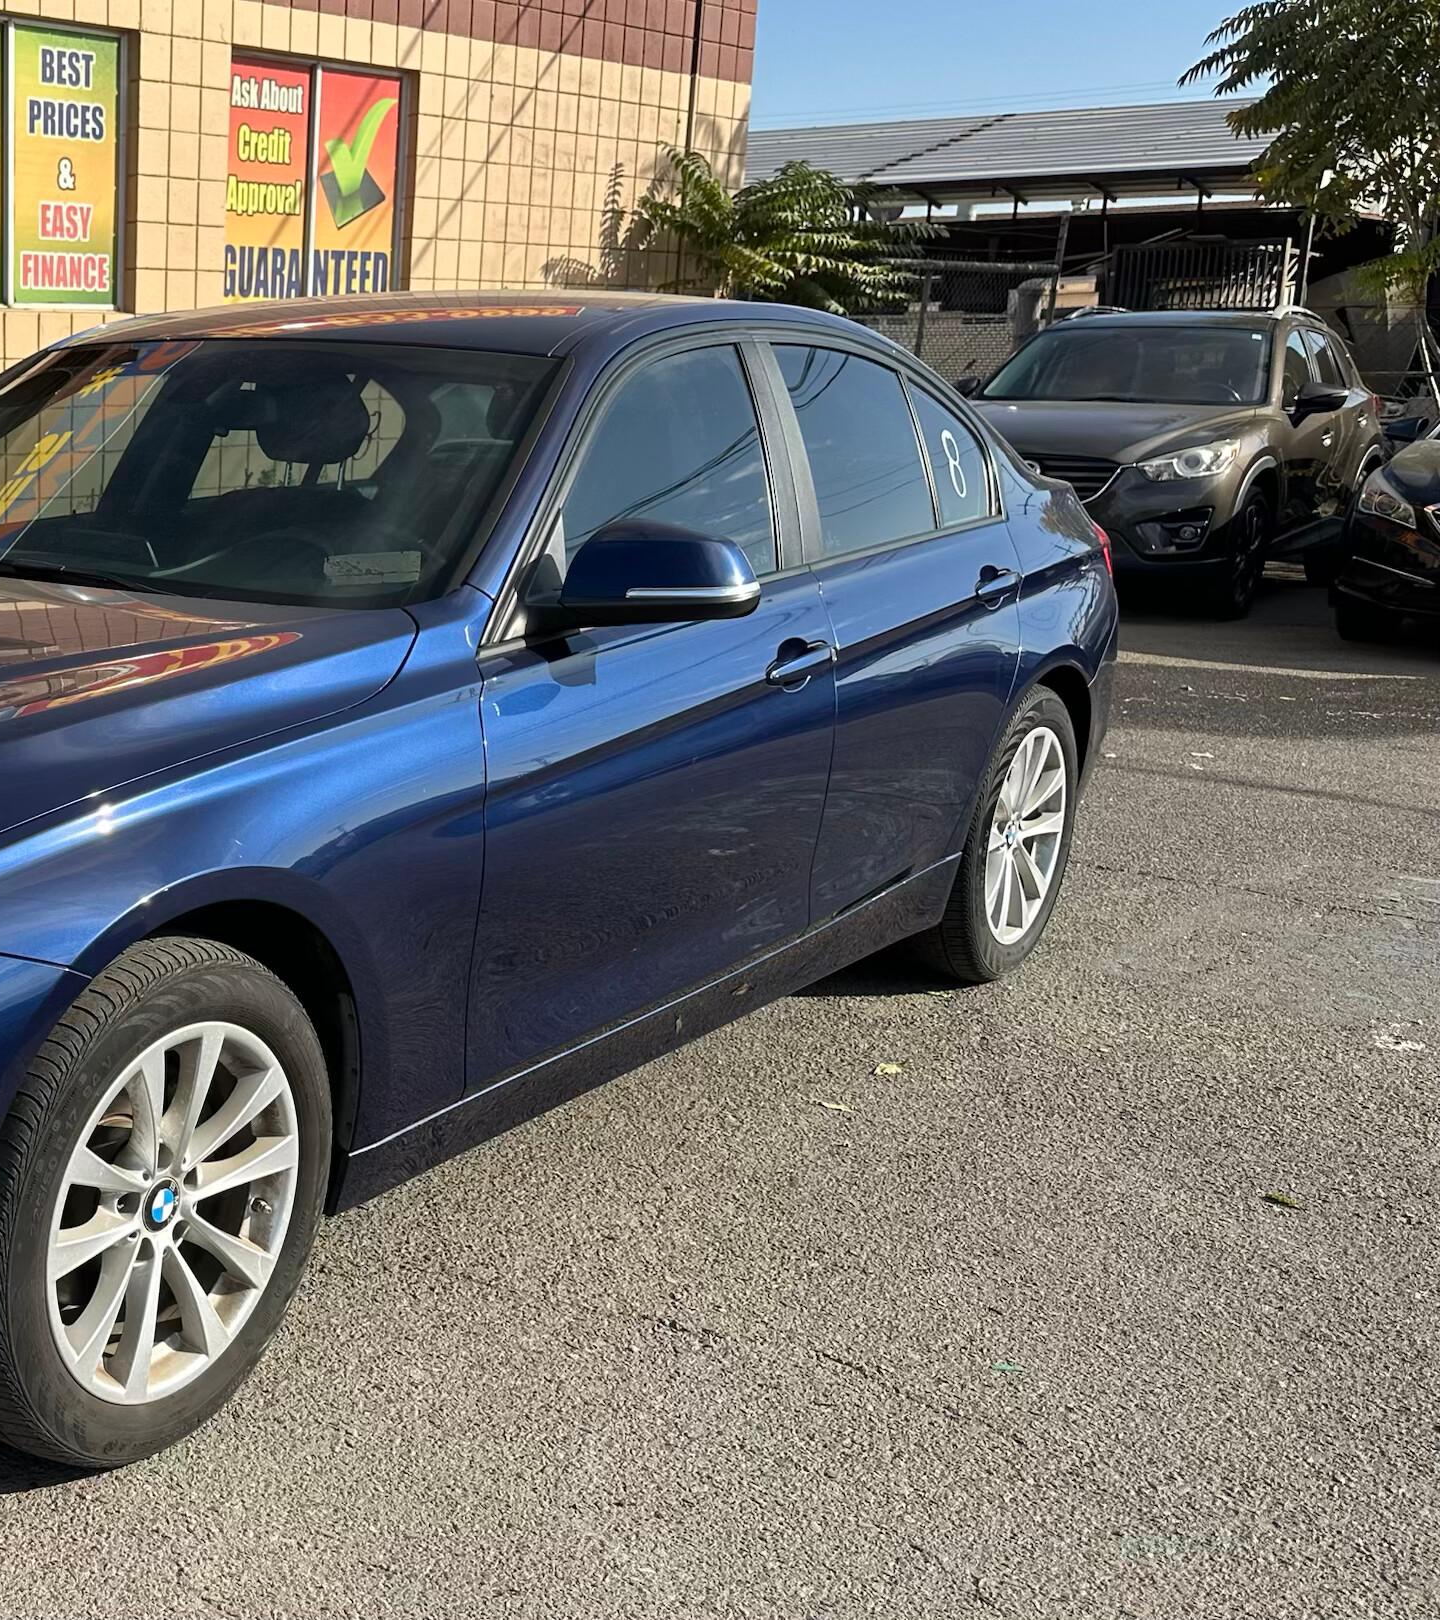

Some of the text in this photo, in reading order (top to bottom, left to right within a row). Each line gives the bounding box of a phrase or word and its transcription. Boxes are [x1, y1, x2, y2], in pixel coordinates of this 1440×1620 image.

[41, 48, 94, 88] BEST
[231, 74, 304, 114] Ask About
[29, 98, 104, 141] PRICES
[238, 122, 292, 165] Credit
[57, 157, 76, 191] &
[226, 174, 302, 217] Approval
[40, 203, 92, 240] EASY
[21, 253, 108, 290] FINANCE
[224, 244, 388, 299] GUARANTEED
